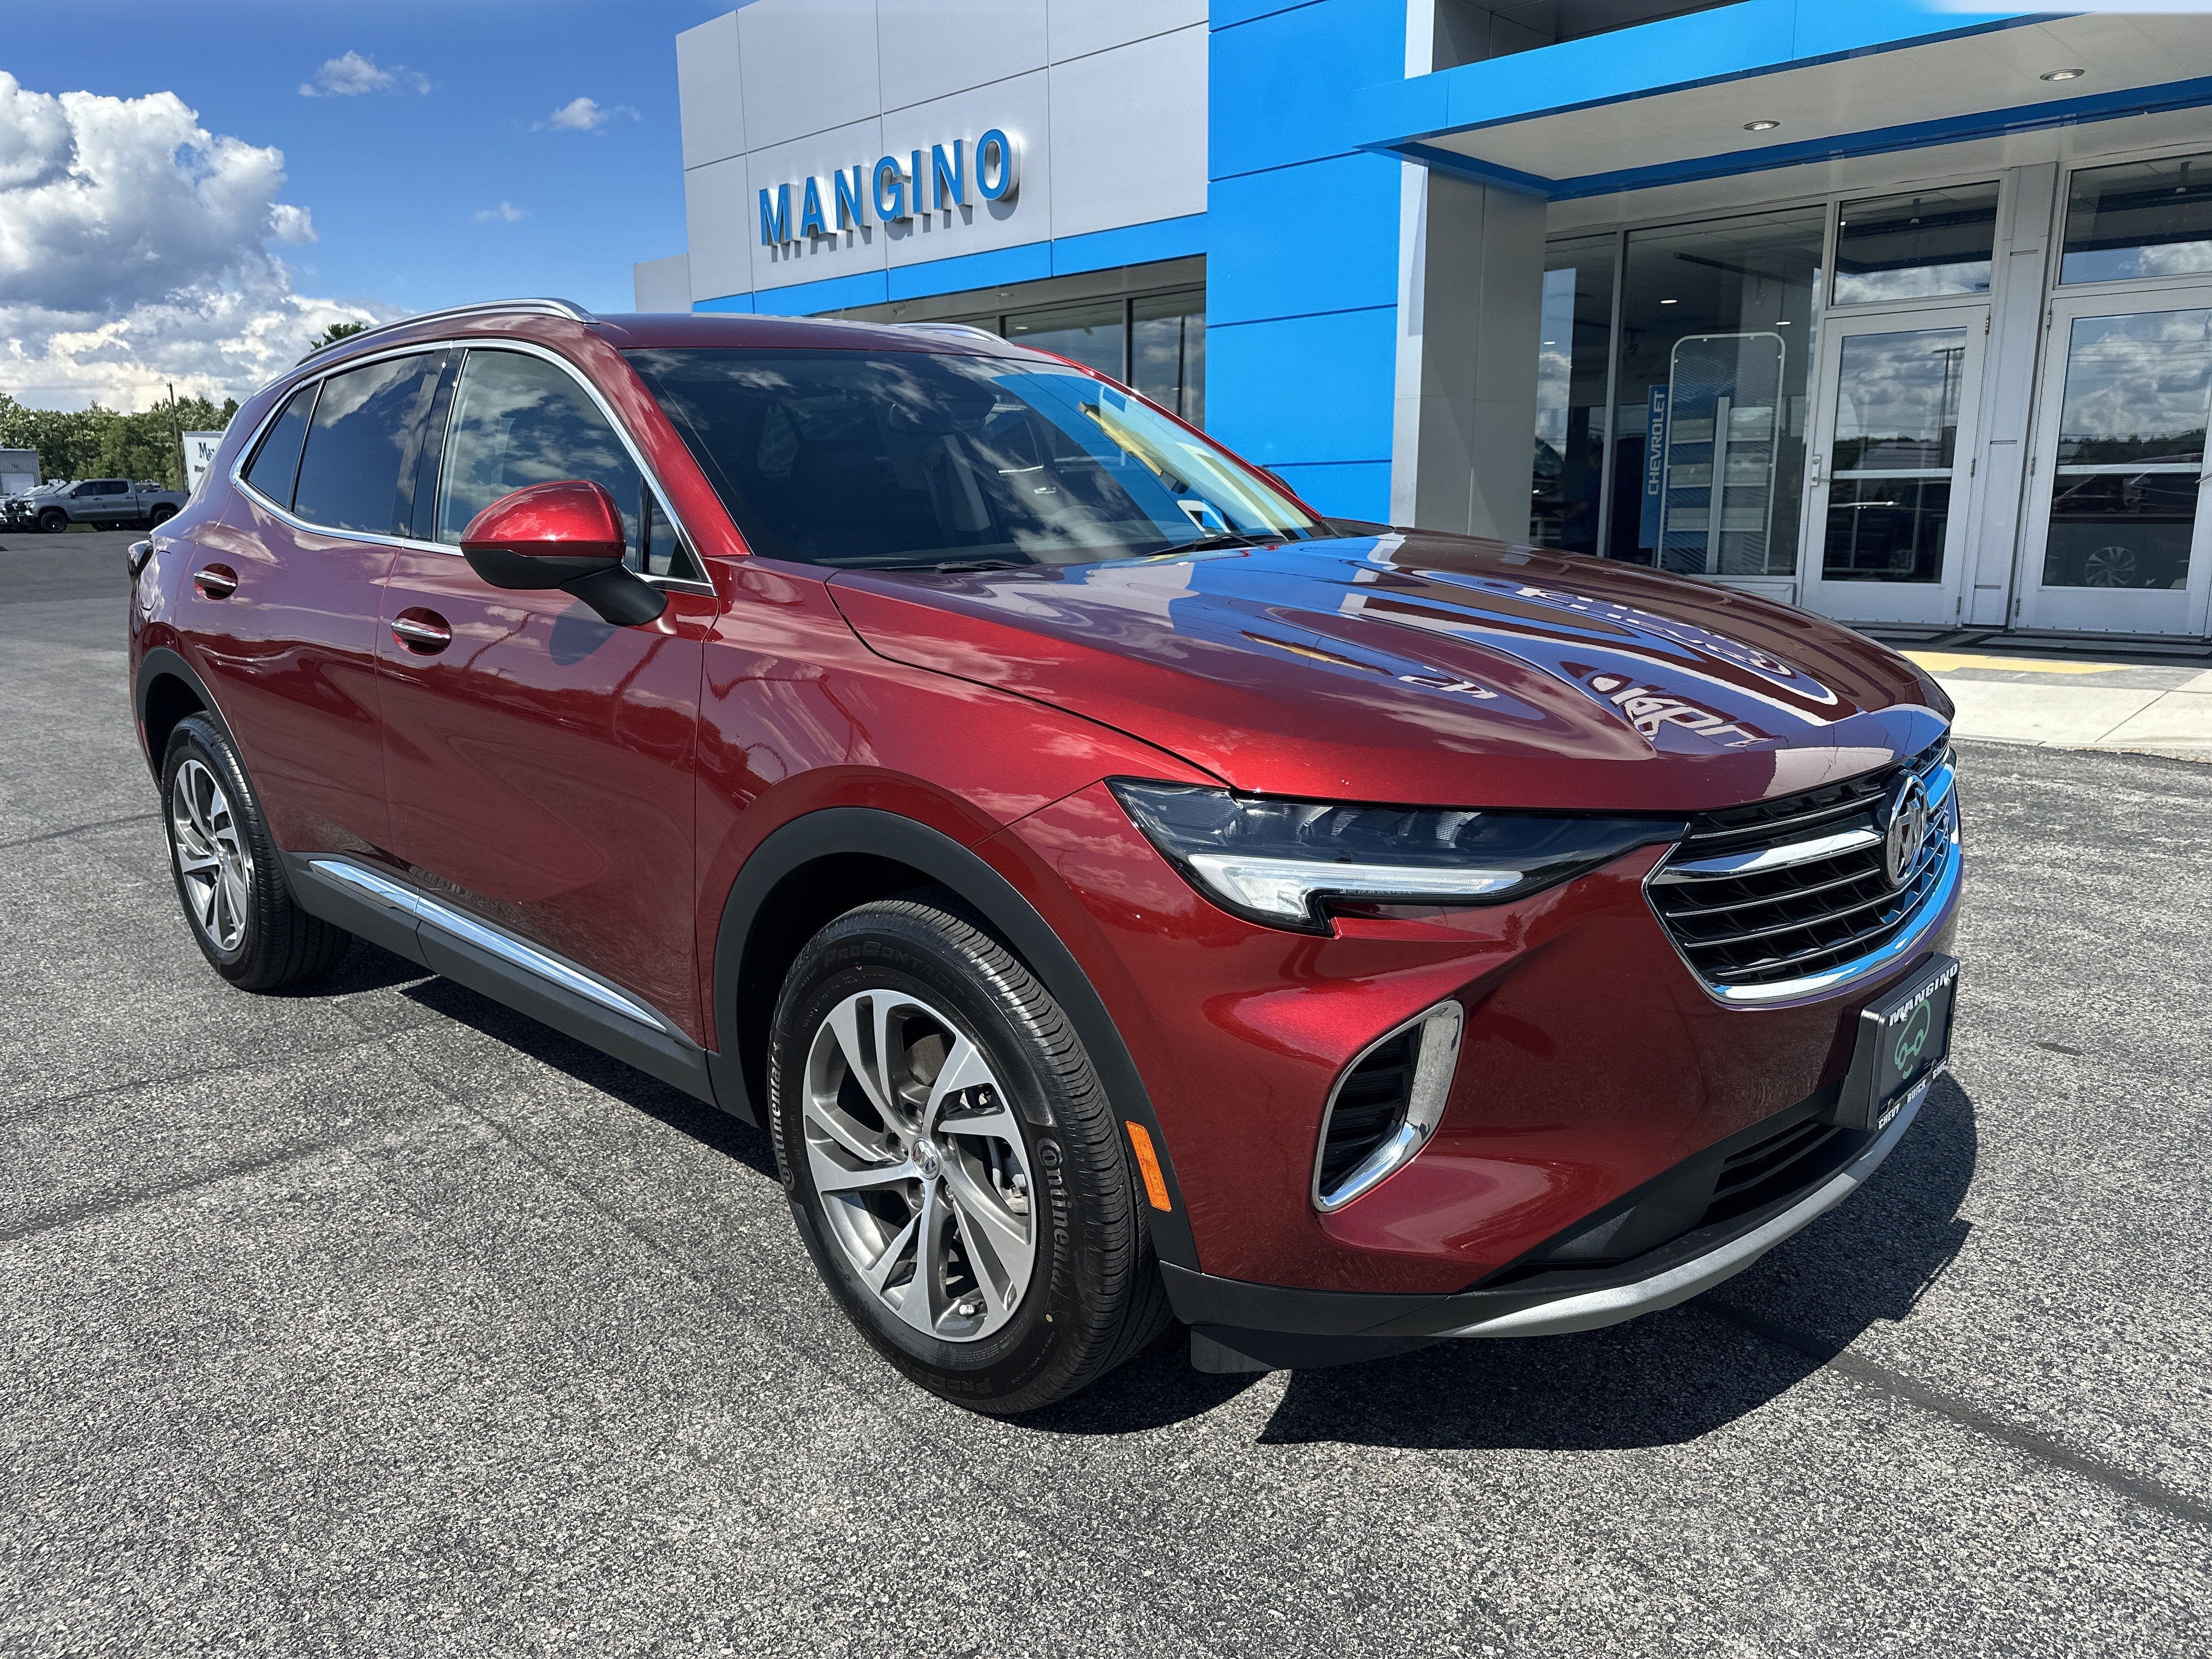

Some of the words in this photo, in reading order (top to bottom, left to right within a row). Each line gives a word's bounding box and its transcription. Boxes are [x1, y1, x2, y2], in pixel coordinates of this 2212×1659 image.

[759, 128, 1012, 247] MANGINO
[1648, 390, 1665, 495] CHEVROLET
[1889, 963, 1958, 1027] MANGINO
[770, 1053, 795, 1191] Continental
[1878, 1103, 1900, 1130] CHEVY
[1907, 1079, 1927, 1104] BUICK
[1036, 1137, 1073, 1300] Continental
